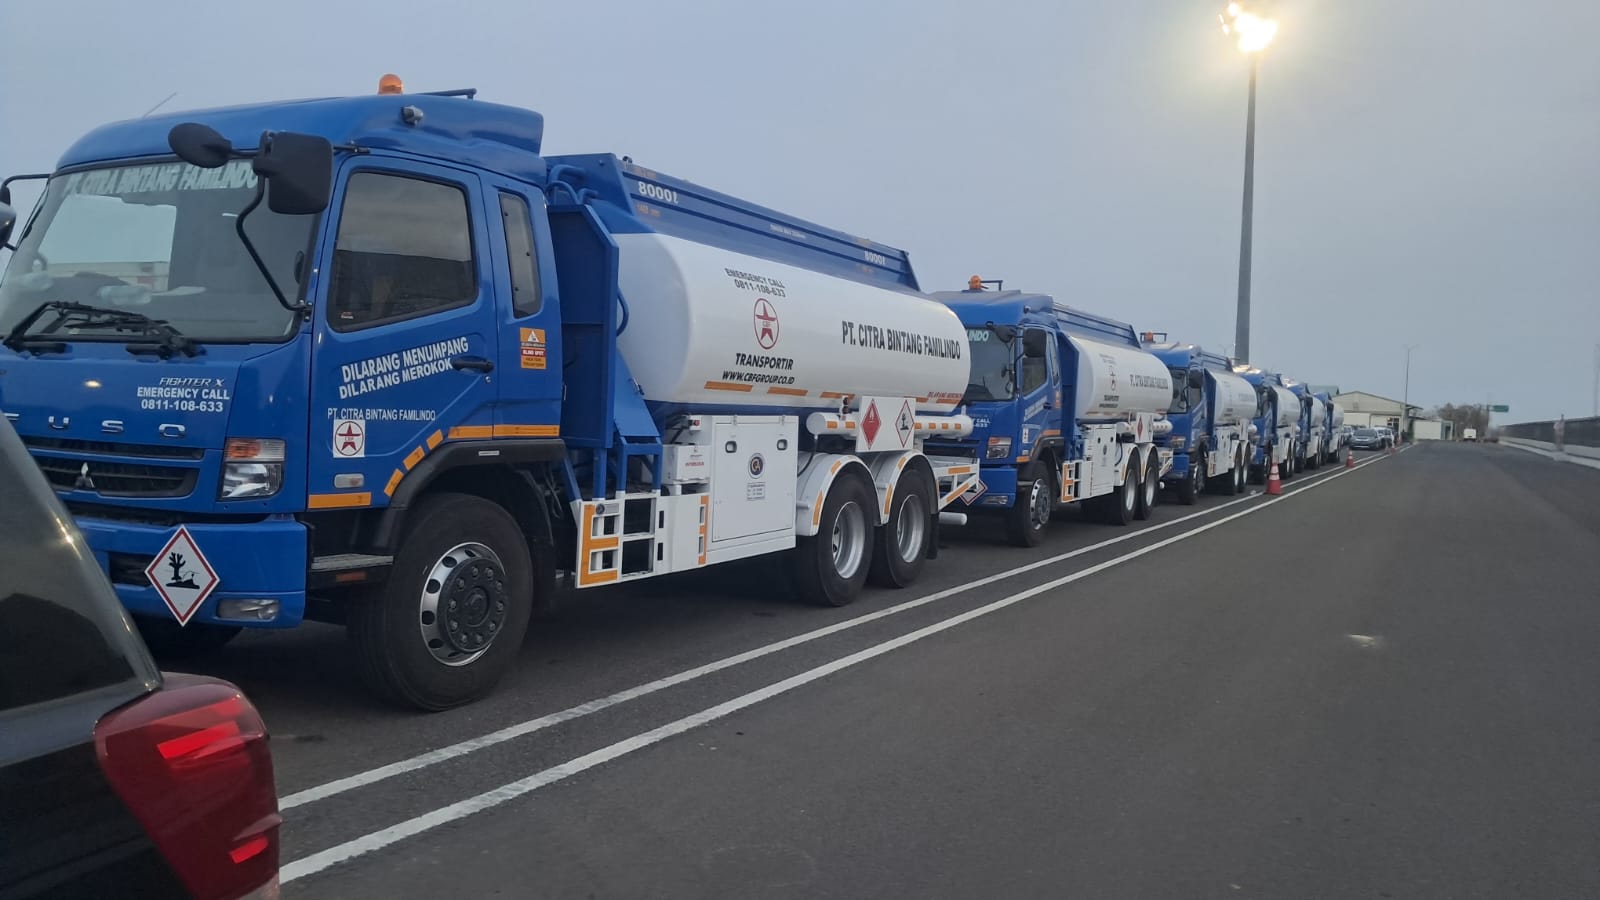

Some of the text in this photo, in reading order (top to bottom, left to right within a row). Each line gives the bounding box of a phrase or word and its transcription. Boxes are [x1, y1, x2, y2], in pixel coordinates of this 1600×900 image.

[724, 268, 786, 289] EMERGENCY CALL
[734, 279, 786, 298] 0811-108-633
[842, 321, 961, 360] PT. CITRA BINTANG FAMILINDO
[967, 329, 990, 343] INDO
[342, 336, 469, 384] DILARANG MENUMPANG
[735, 353, 794, 370] TRANSPORTIR
[159, 377, 225, 387] FIGHTER X
[339, 358, 454, 400] DILARANG MEROKOK
[722, 370, 796, 385] WWW.CBFGROUP.CO.ID
[137, 386, 230, 400] EMERGENCY CALL
[141, 398, 224, 412] 0811-108-633
[327, 407, 436, 421] PT. CITRA BINTANG FAMILINDO
